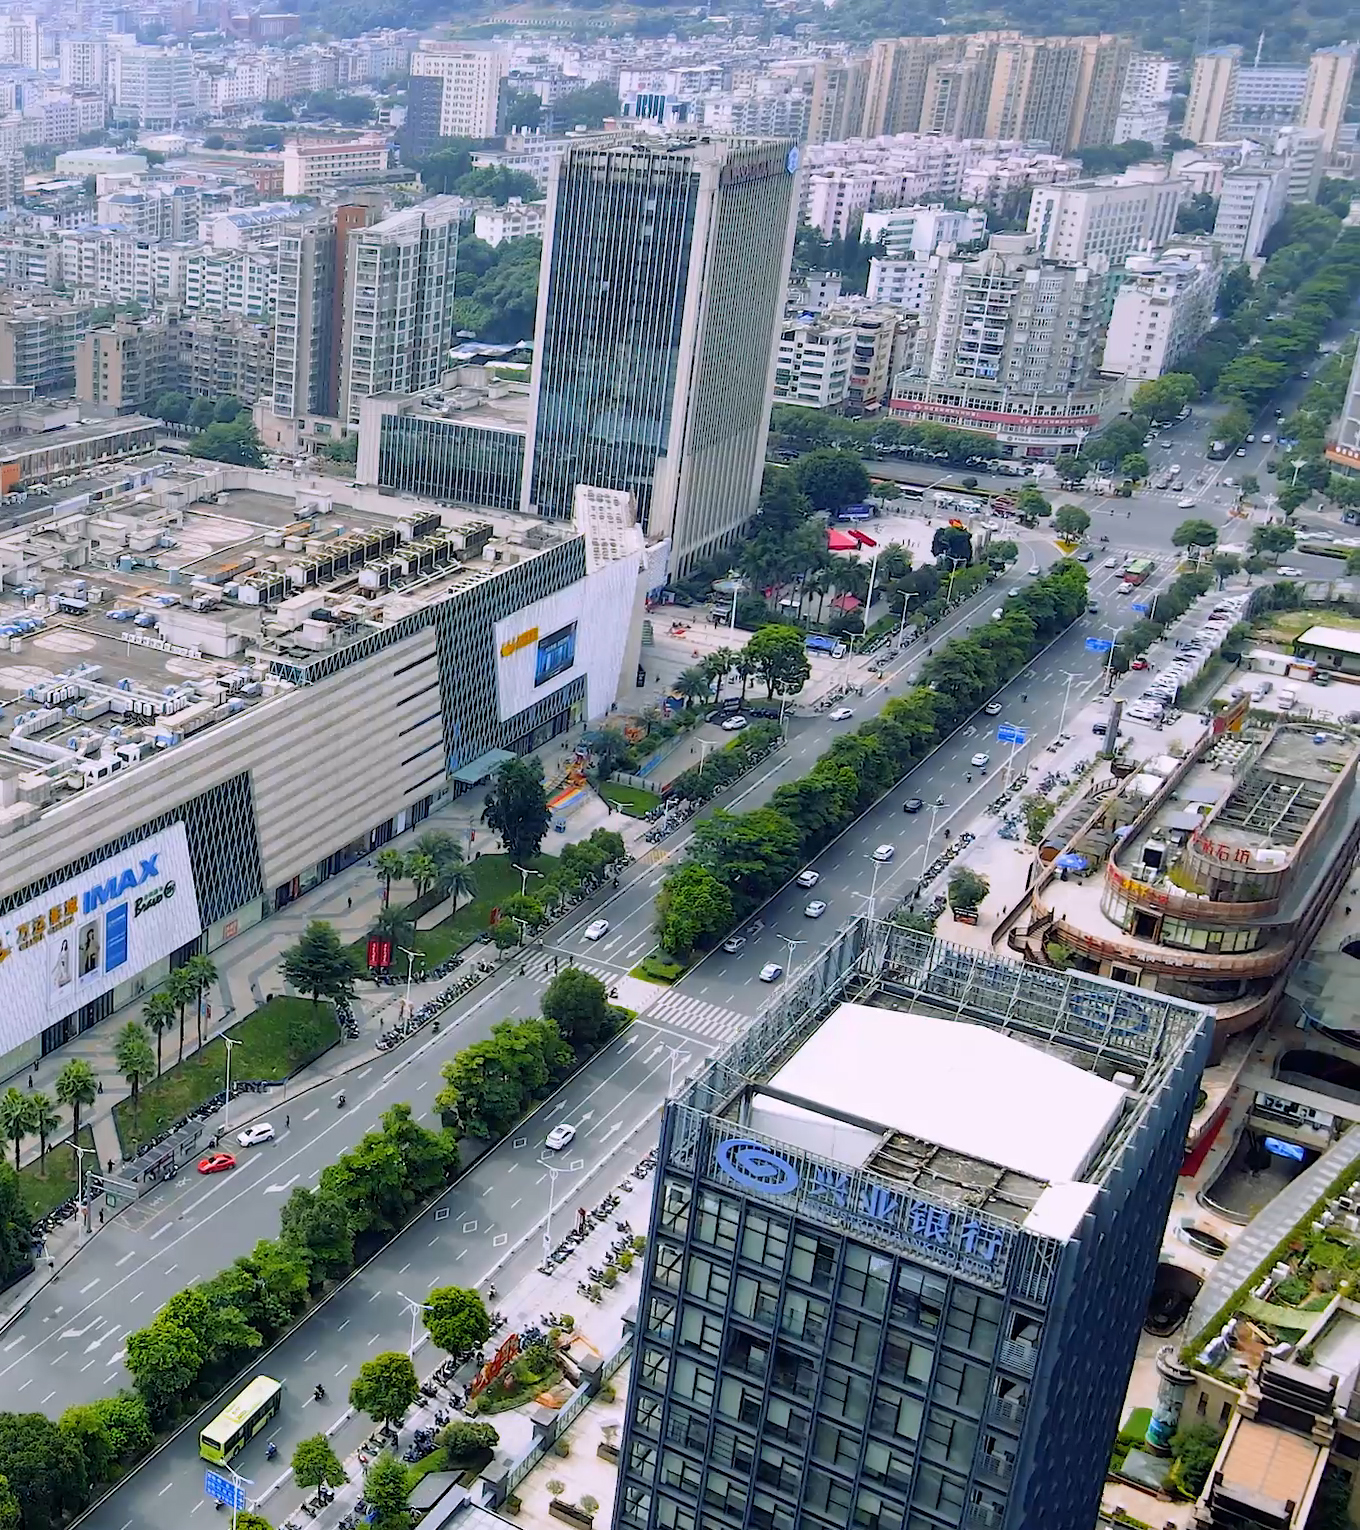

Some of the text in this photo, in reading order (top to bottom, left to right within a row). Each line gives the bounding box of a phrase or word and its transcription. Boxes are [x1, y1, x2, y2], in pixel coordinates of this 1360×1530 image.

[82, 852, 160, 914] IMAX
[809, 1168, 1004, 1261] 兴业银行
